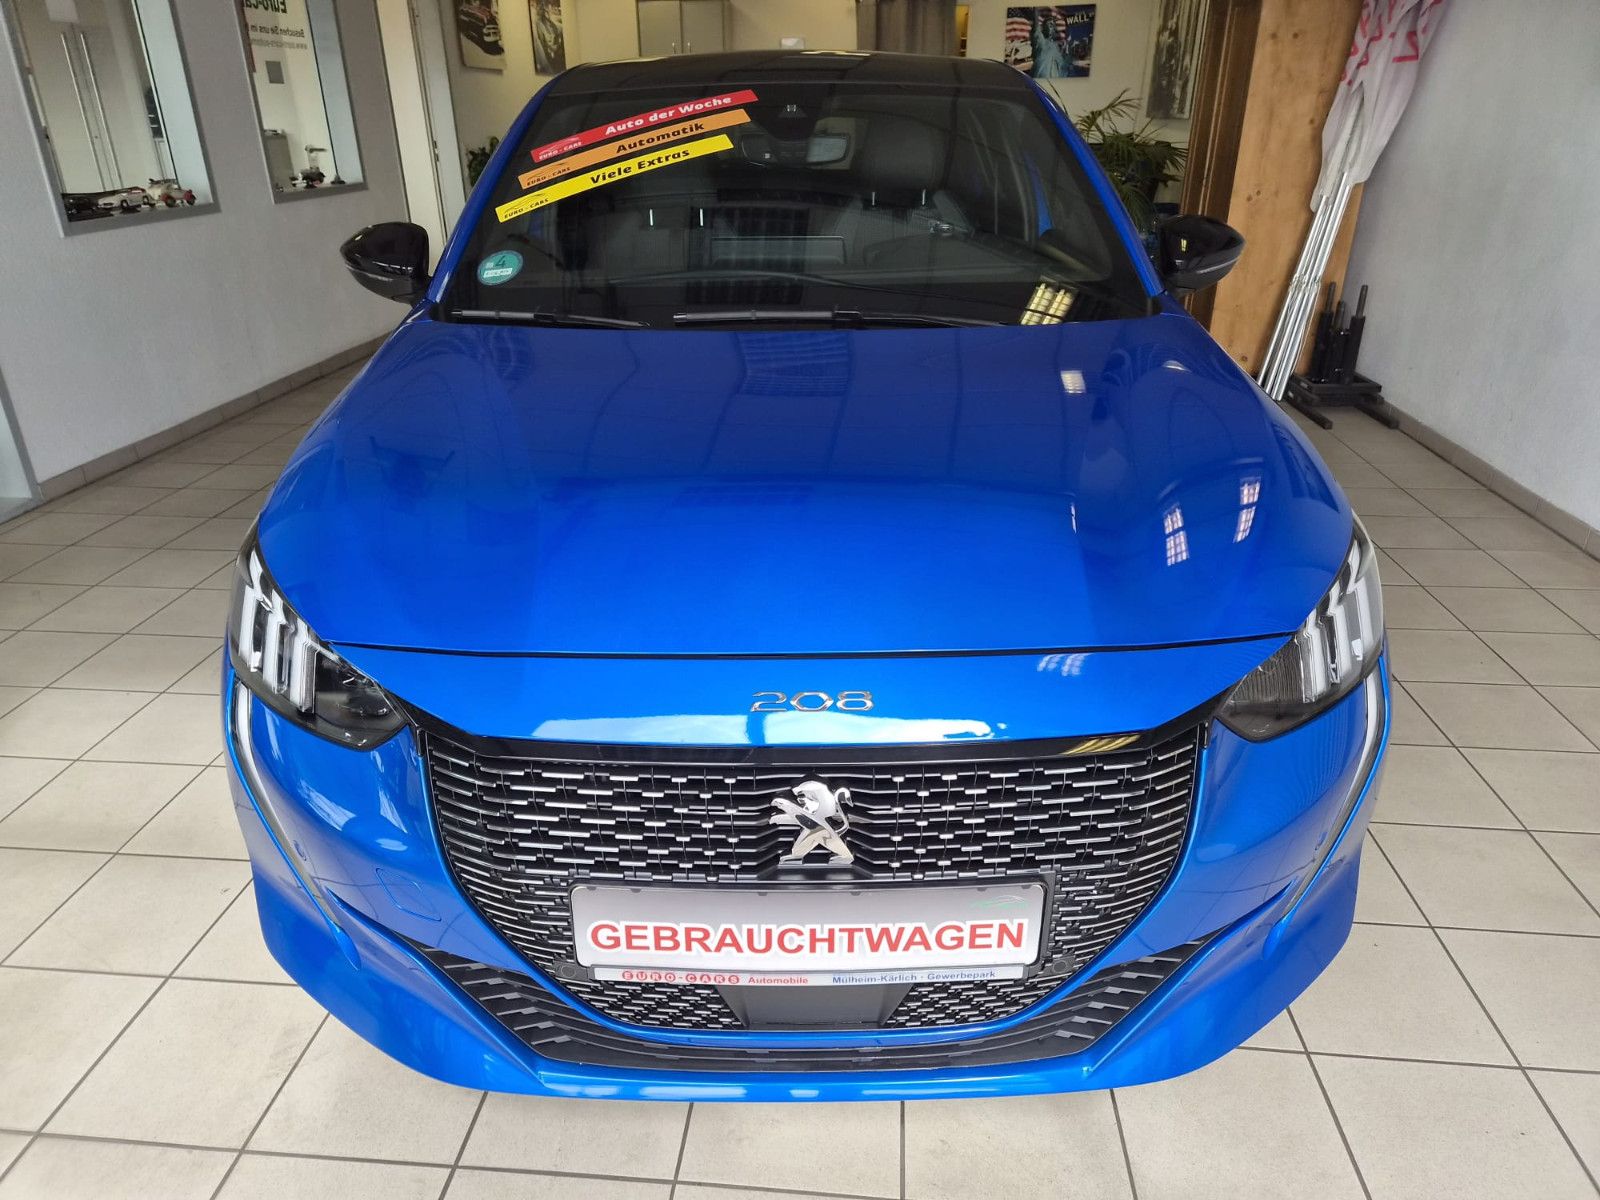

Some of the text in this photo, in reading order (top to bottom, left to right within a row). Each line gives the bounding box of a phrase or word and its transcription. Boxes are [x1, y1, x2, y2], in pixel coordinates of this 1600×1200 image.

[1066, 14, 1088, 25] WALL
[604, 95, 733, 136] Auto der Woche
[615, 121, 705, 155] Automatik
[589, 148, 691, 185] Viele Extras
[495, 254, 507, 268] 4
[751, 690, 875, 713] 208
[589, 921, 1026, 955] GEBRAUCHTWAGEN
[748, 976, 809, 985] Automobile
[832, 973, 917, 985] Mülheim-Kärlich
[927, 970, 996, 982] Gewerbepark
